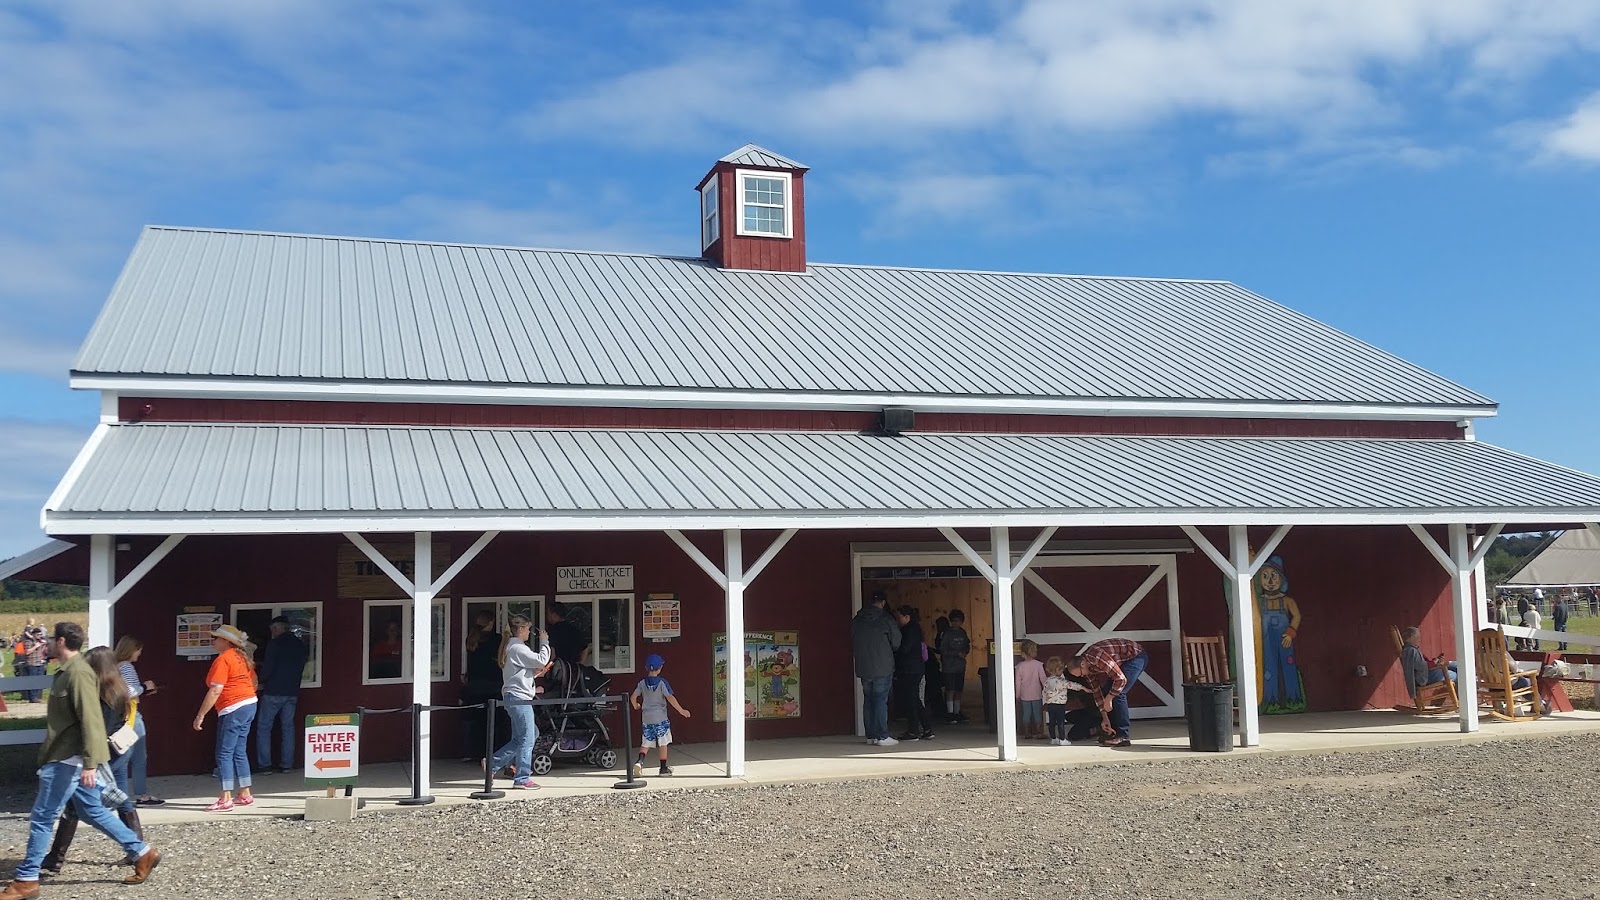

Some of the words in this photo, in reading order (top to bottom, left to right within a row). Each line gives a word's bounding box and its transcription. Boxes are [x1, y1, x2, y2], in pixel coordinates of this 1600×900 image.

[558, 567, 595, 579] ONLINE
[597, 567, 632, 578] TICKET
[568, 578, 615, 590] CHECK-IN
[308, 732, 356, 743] ENTER
[313, 742, 351, 753] HERE
